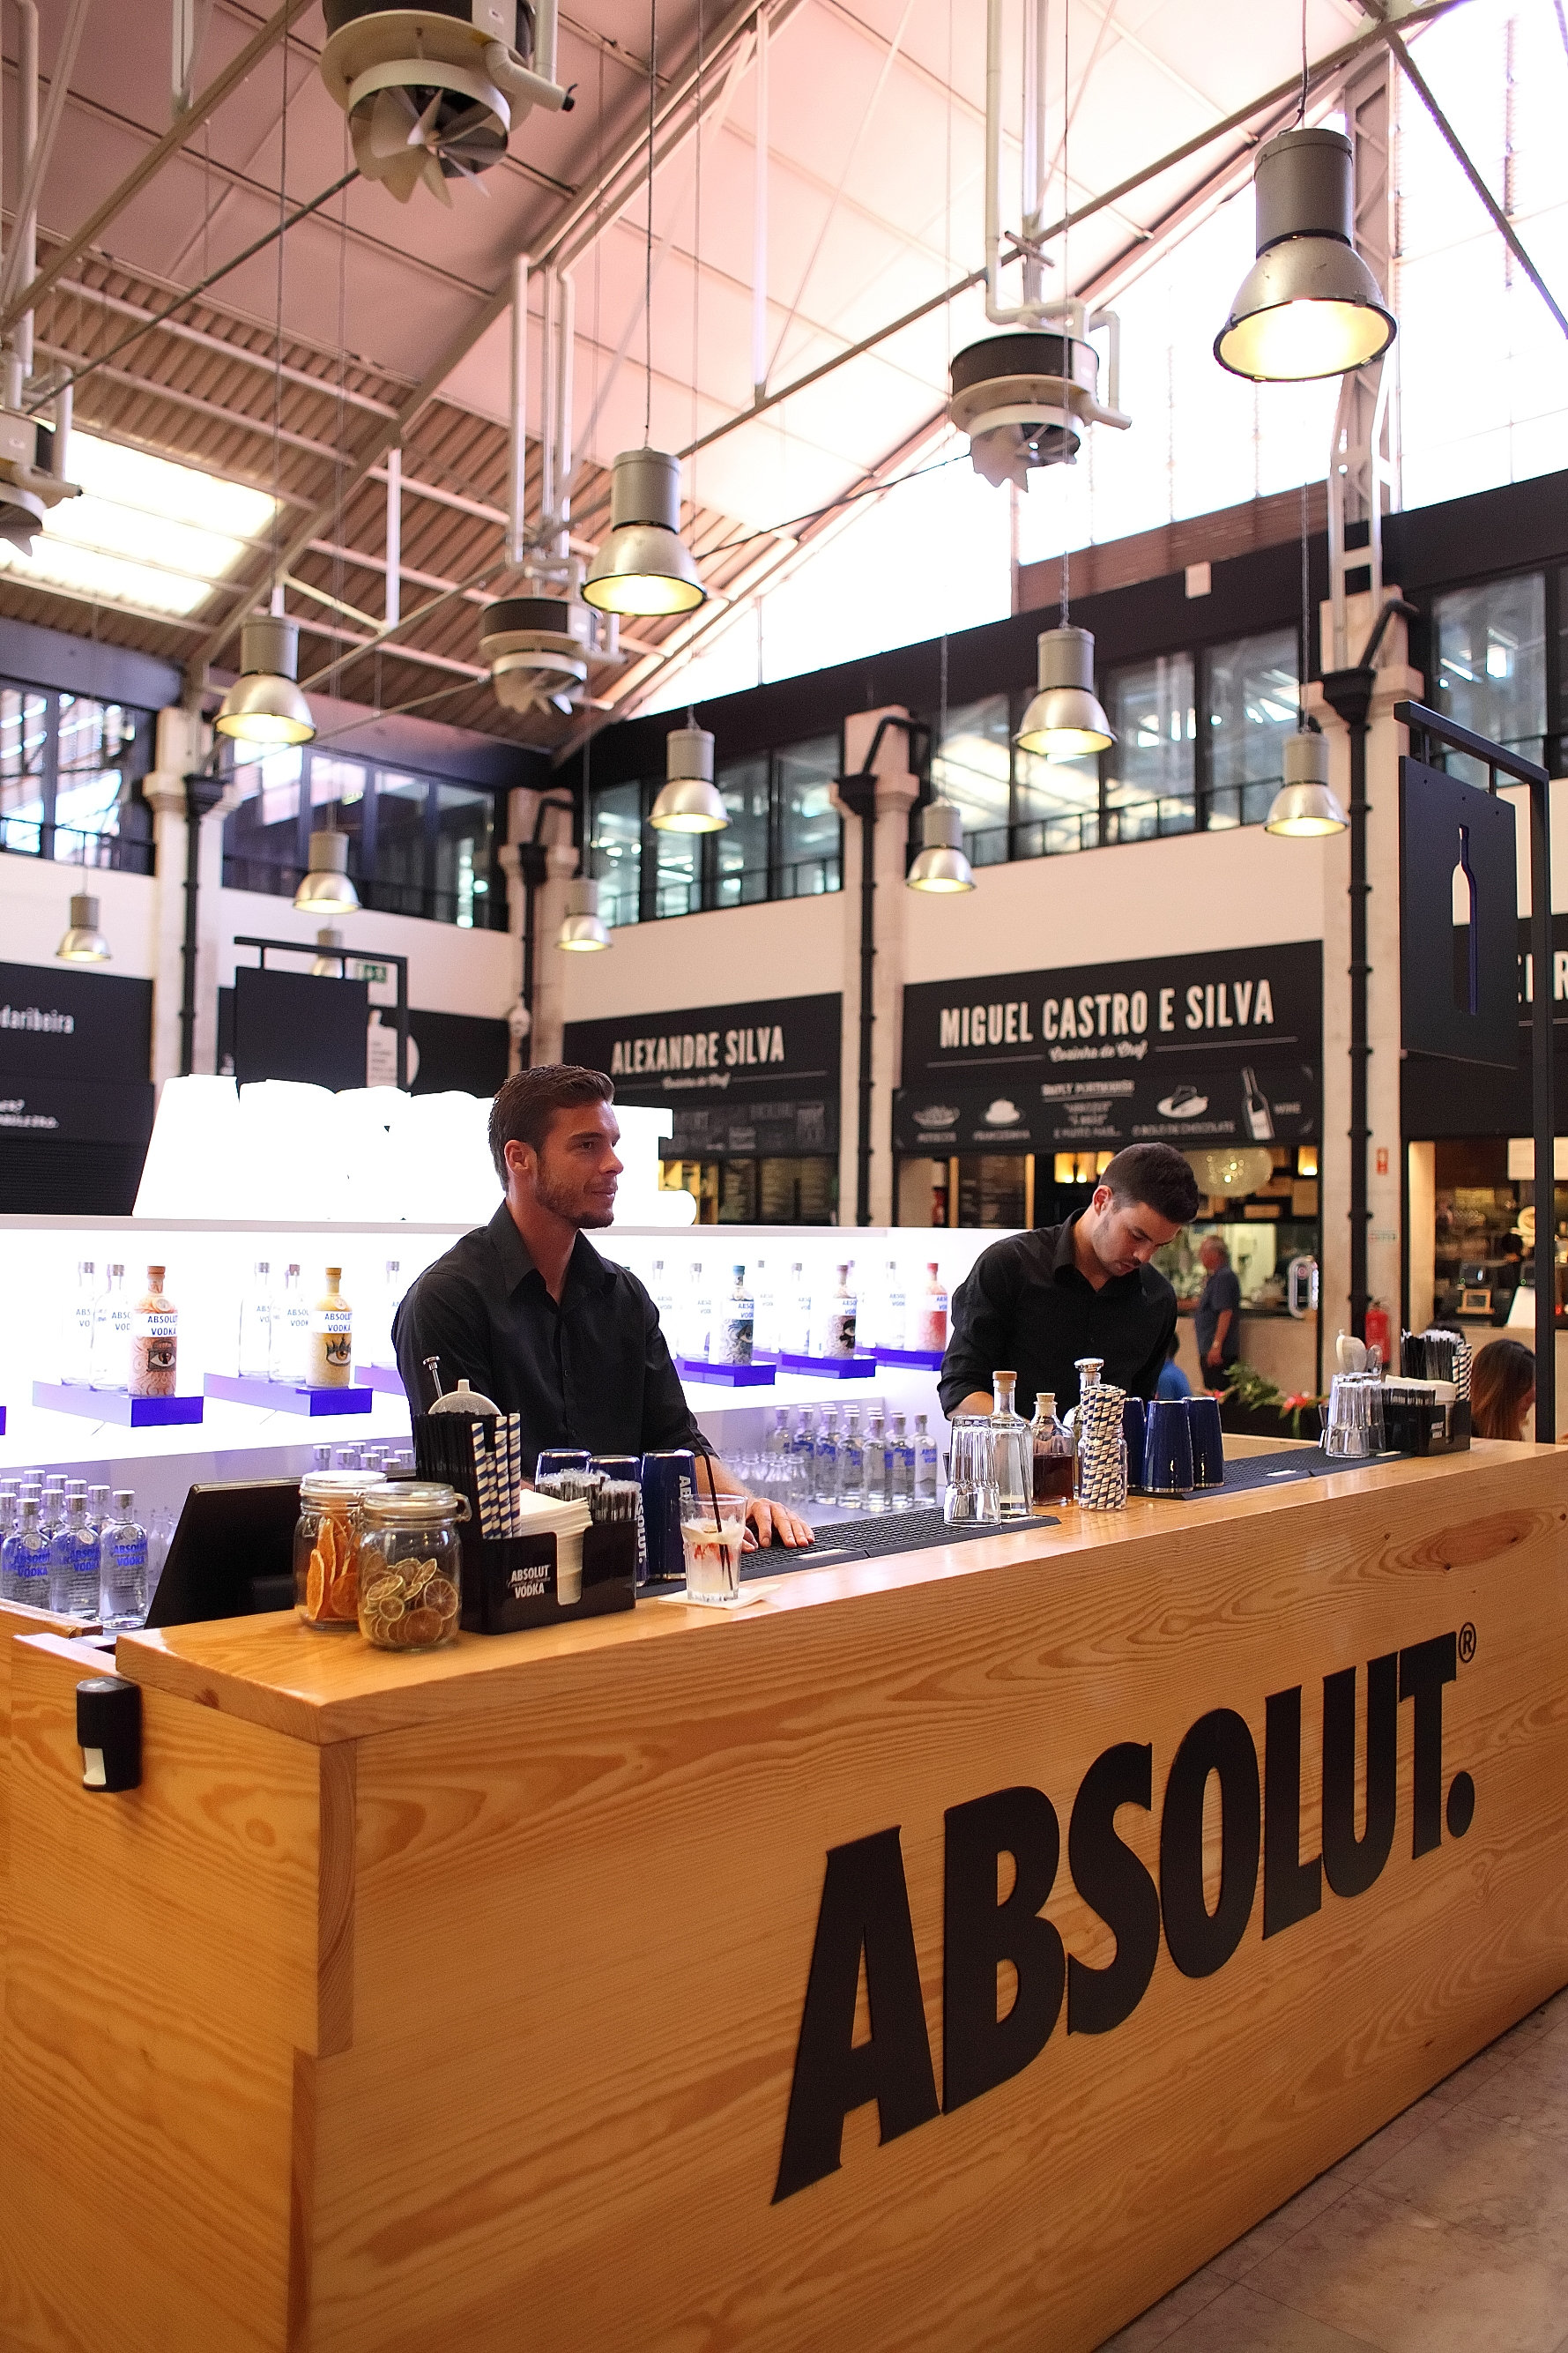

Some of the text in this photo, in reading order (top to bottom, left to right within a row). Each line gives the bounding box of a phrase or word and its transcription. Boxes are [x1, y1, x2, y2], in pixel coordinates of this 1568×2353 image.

[939, 979, 1274, 1049] MIGUEL CASTRO E SILVA
[611, 1025, 784, 1076] ALEXANDRE SILVA
[511, 1564, 550, 1582] ABSOLUT
[515, 1582, 545, 1599] VODKA
